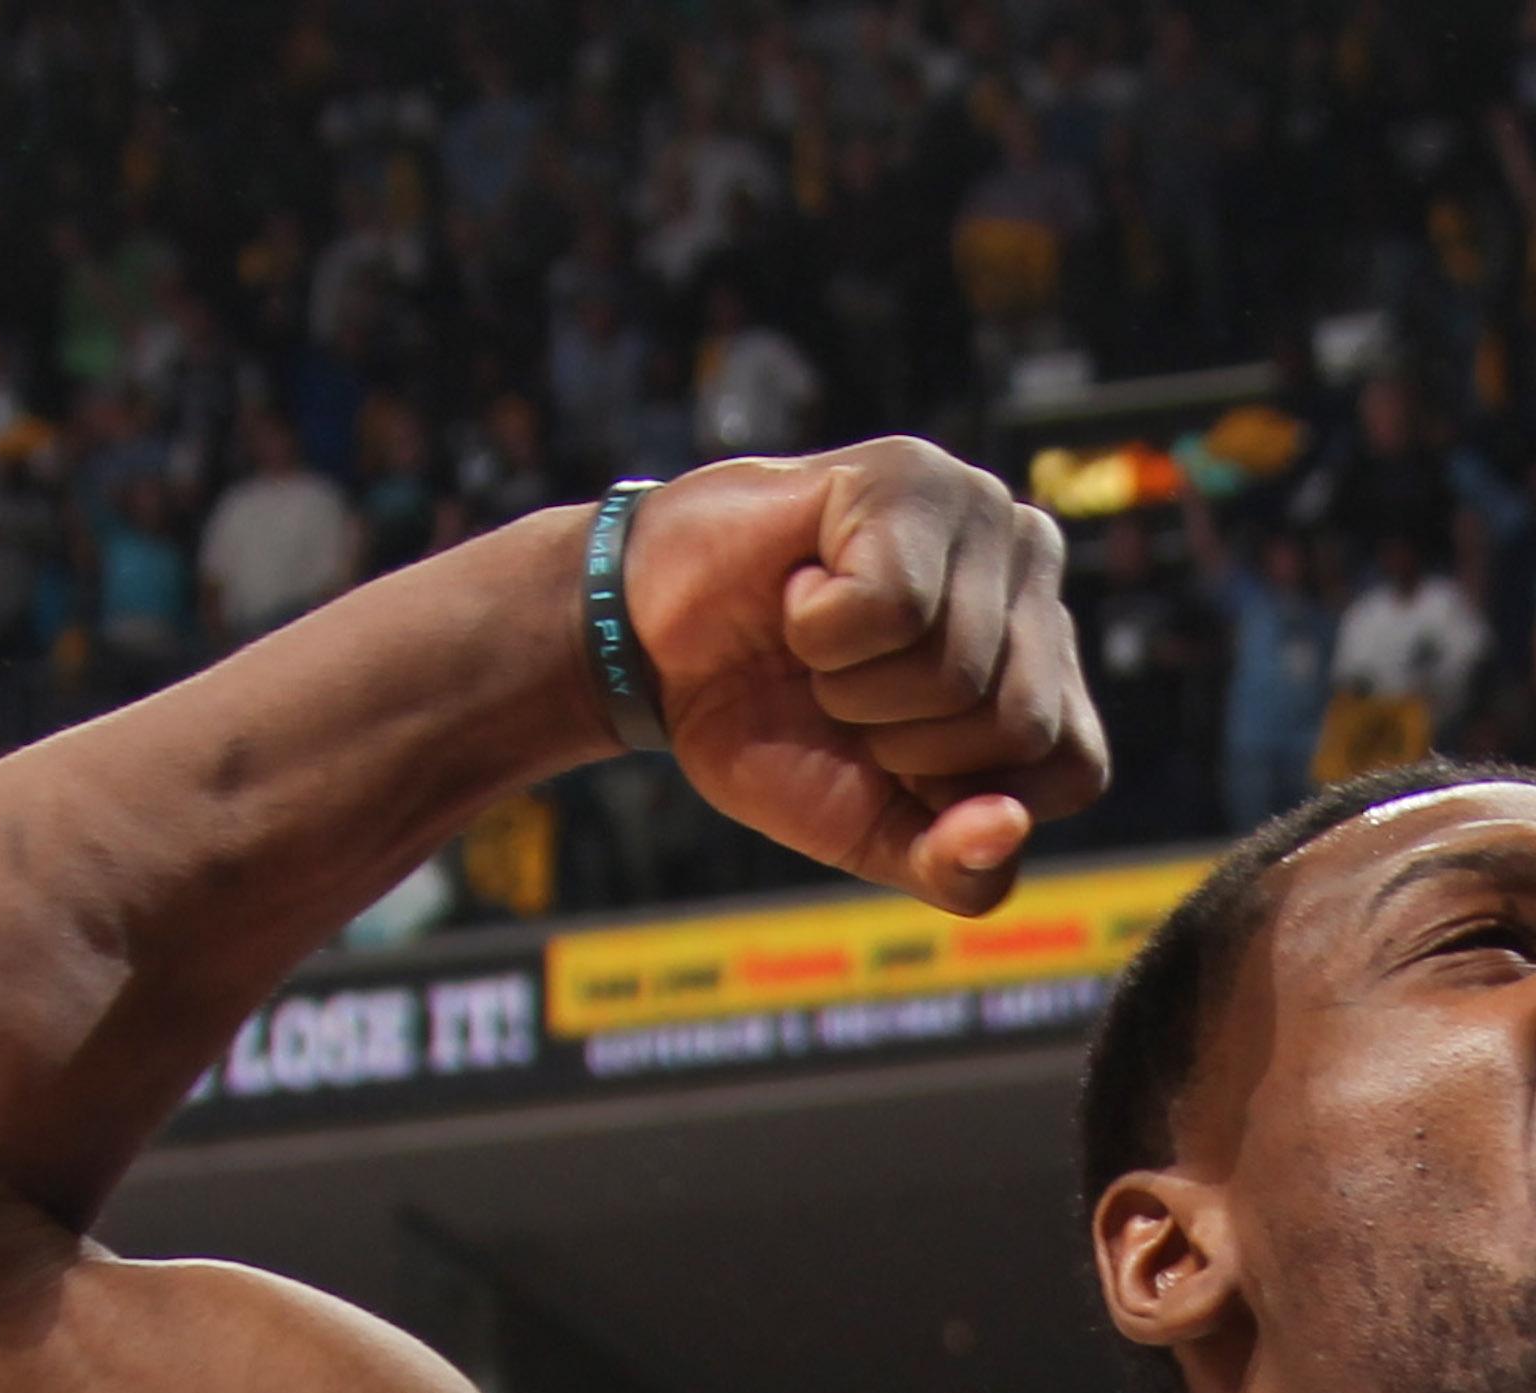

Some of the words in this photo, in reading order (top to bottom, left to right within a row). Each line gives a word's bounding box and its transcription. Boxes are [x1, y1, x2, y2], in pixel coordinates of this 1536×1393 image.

[595, 618, 631, 695] PLAY
[226, 991, 418, 1095] LOSE
[429, 973, 534, 1073] IT!
